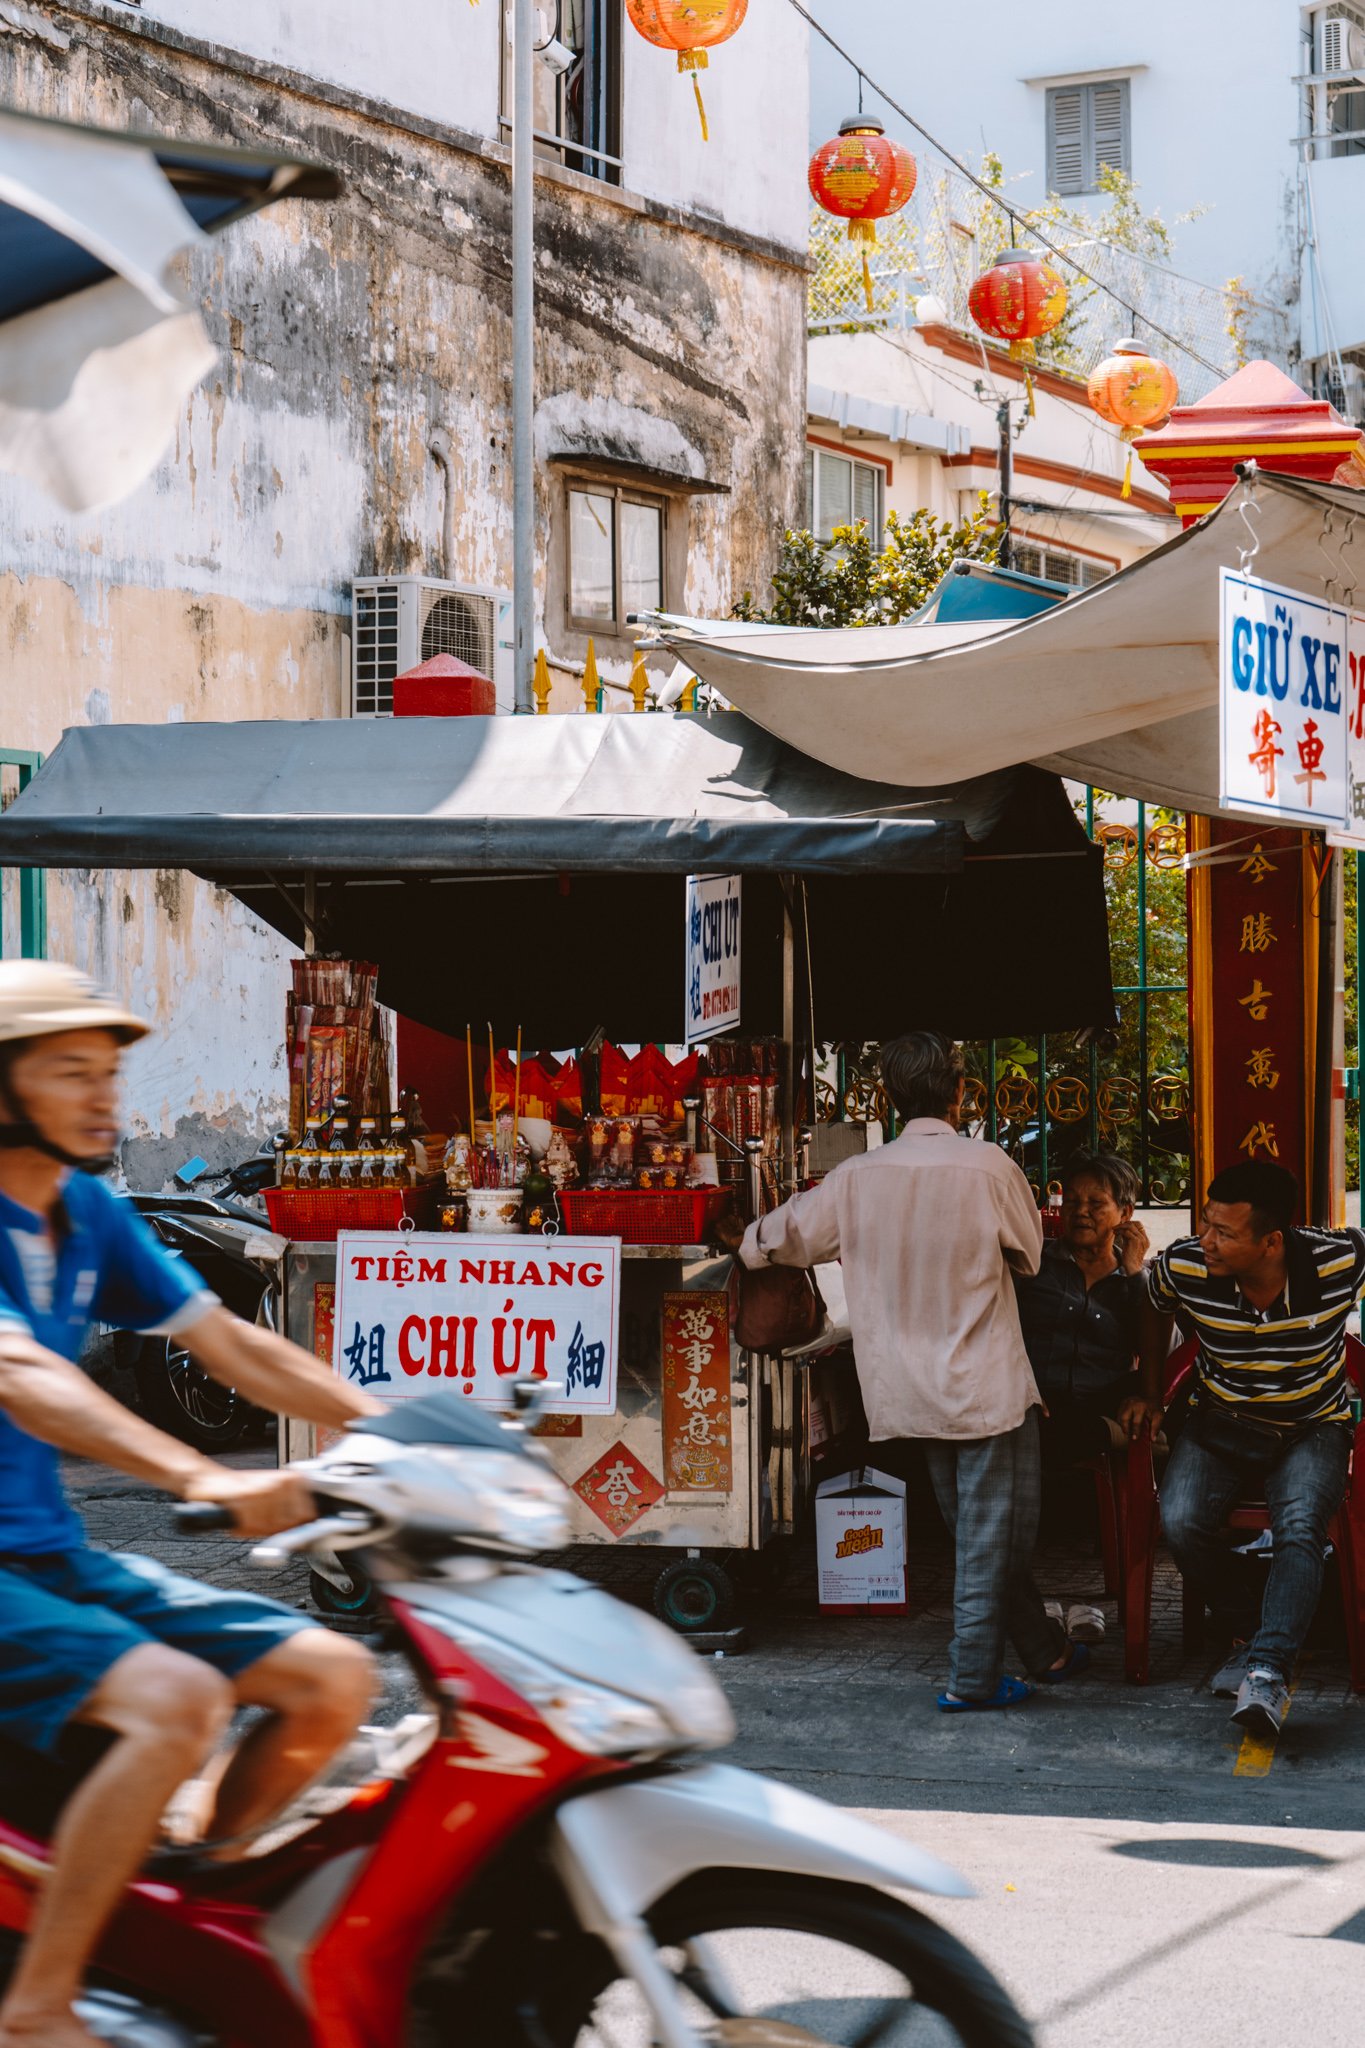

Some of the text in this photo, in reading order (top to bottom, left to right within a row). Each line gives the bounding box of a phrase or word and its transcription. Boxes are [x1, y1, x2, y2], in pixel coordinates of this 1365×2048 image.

[1231, 604, 1293, 701] GIỮ
[1300, 635, 1341, 715] XE
[1247, 708, 1327, 807] 寄車
[703, 901, 722, 979] CHỊ
[725, 880, 739, 957] ÚT
[351, 1250, 605, 1288] TIỆM NHANG
[344, 1321, 392, 1387] 姐
[398, 1298, 556, 1395] CHỊ ÚT
[566, 1320, 606, 1397] 細
[677, 1308, 717, 1446] 萬事如意
[844, 1525, 871, 1541] Good
